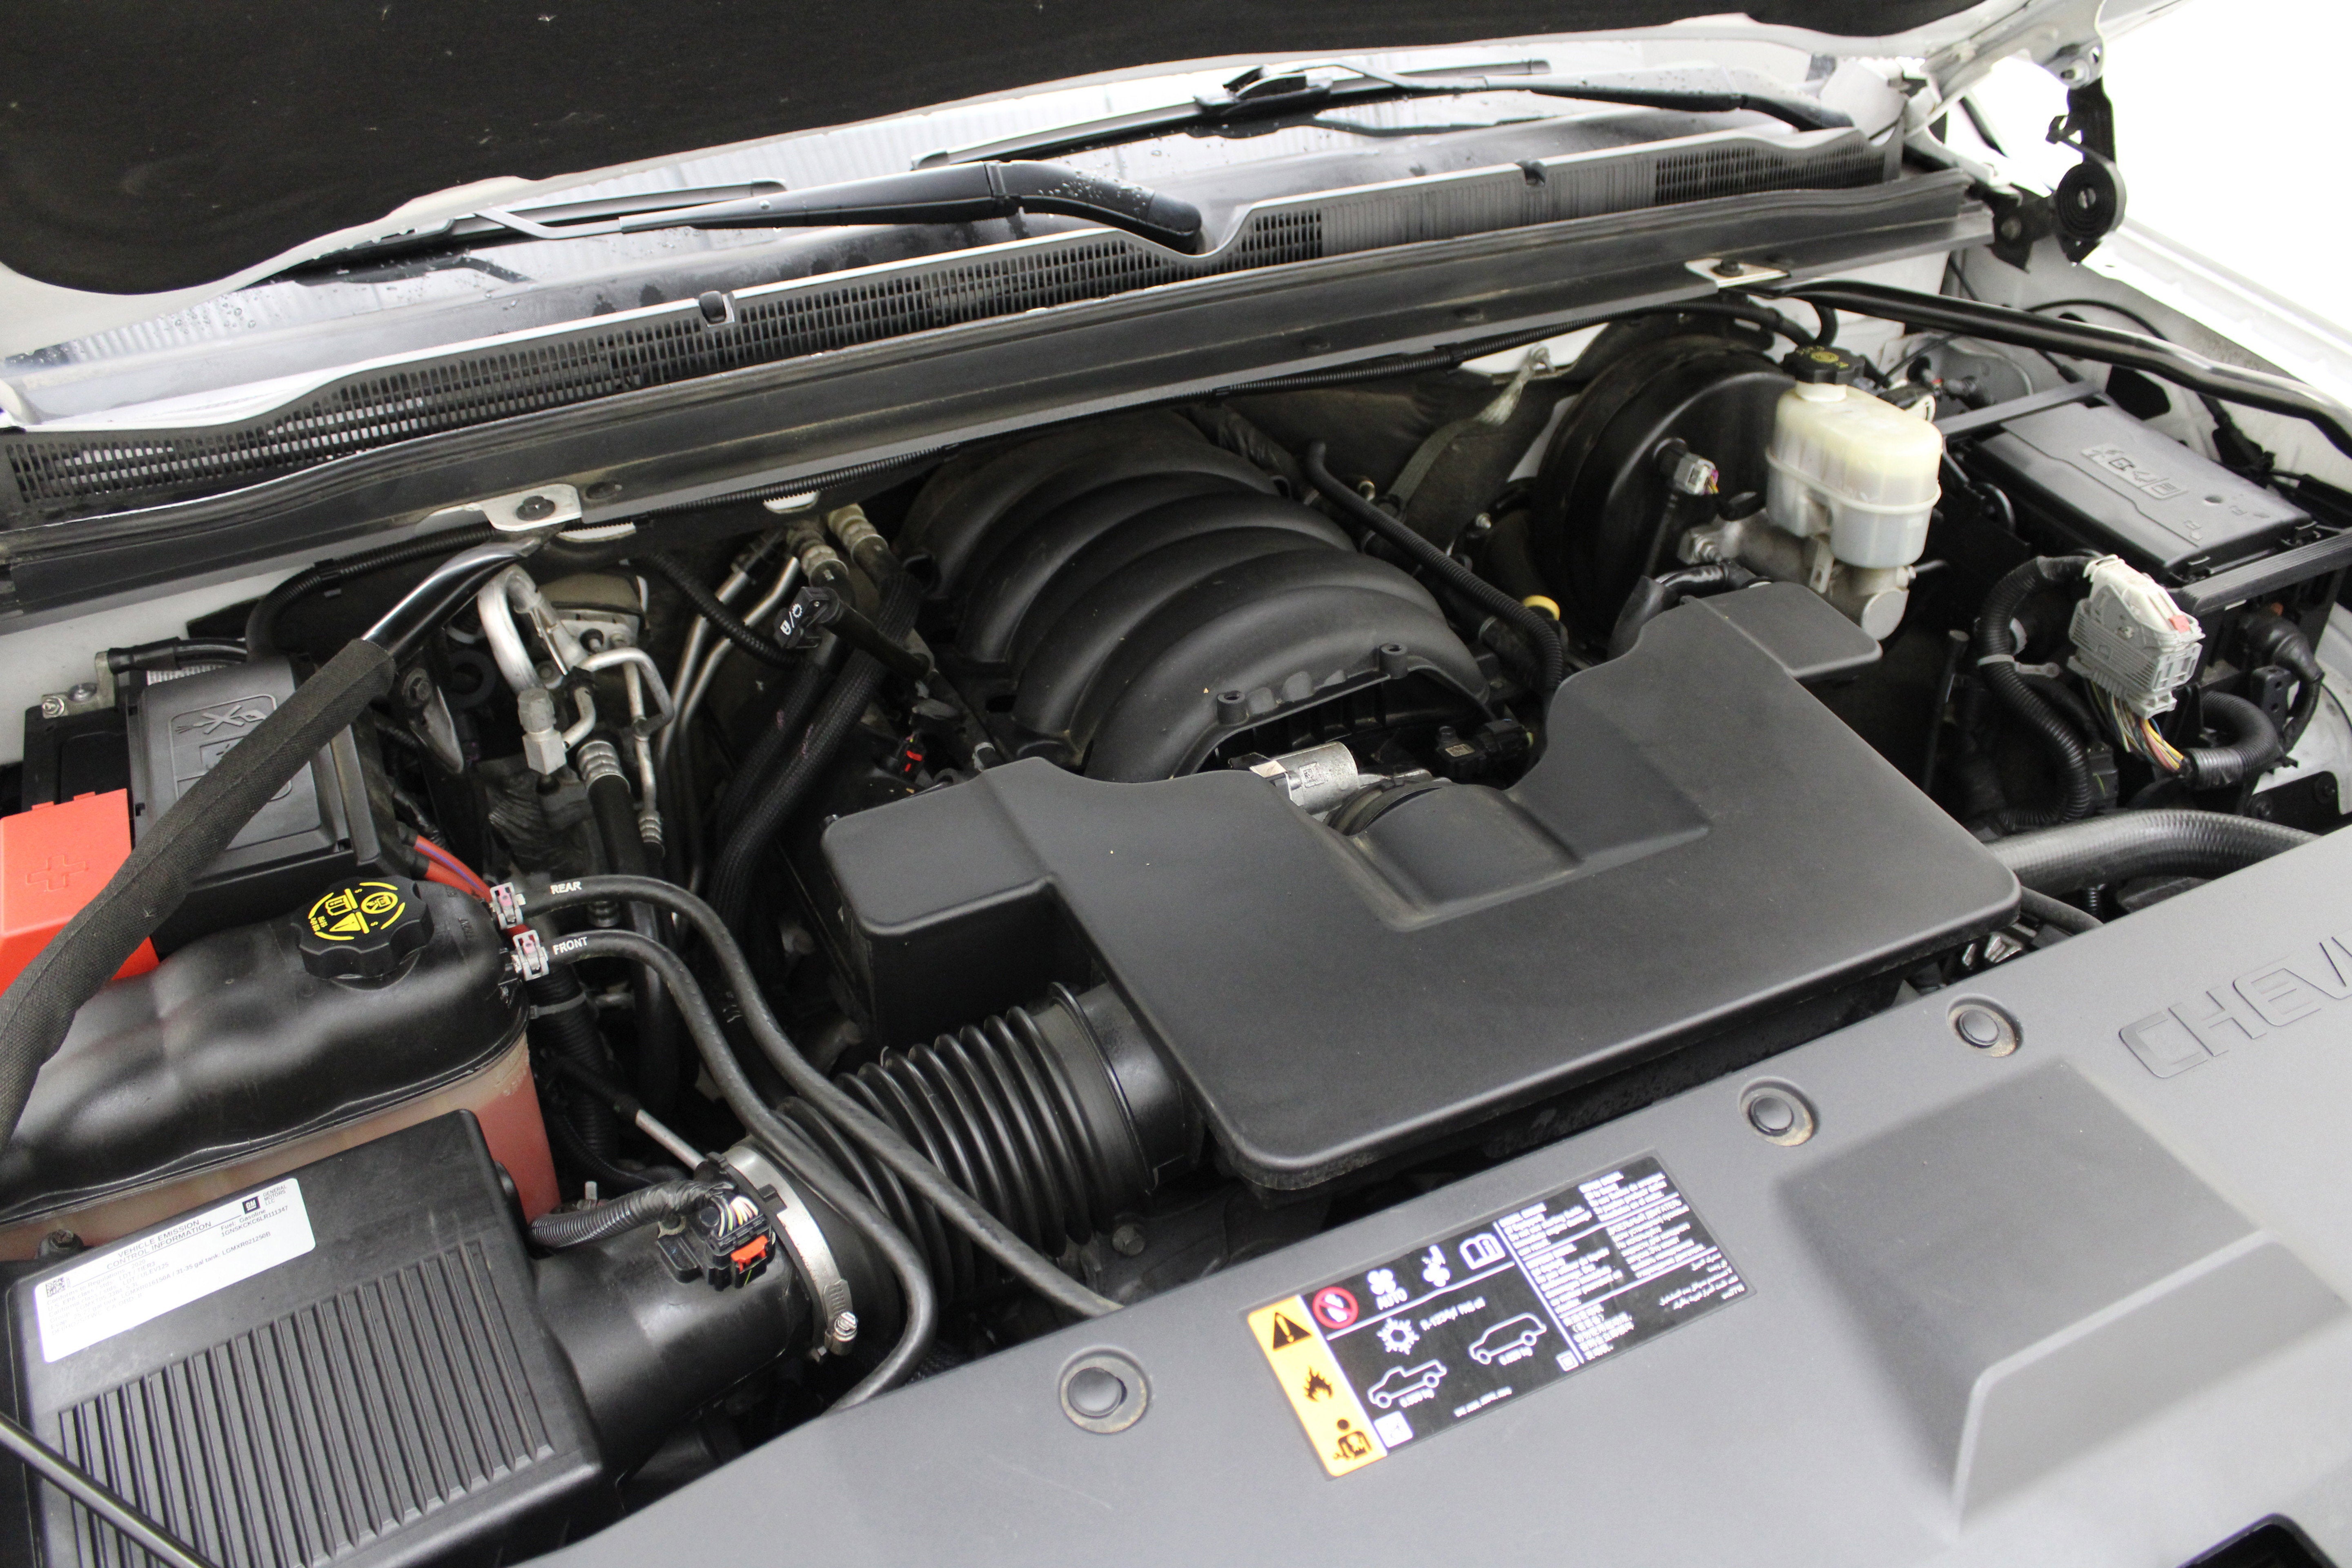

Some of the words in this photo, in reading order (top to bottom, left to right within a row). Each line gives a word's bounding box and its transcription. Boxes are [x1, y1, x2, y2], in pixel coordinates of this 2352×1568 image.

[550, 881, 582, 895] REAR
[552, 937, 587, 955] FRONT
[2118, 930, 2352, 1078] CHEV
[263, 1184, 287, 1197] GENERAL
[264, 1189, 286, 1201] MOTORS
[245, 1200, 257, 1210] GM
[220, 1221, 236, 1230] Fuel:
[239, 1209, 266, 1223] Gasoline
[106, 1247, 149, 1269] CONTROL
[150, 1221, 212, 1250] INFORMATION
[118, 1238, 156, 1258] VEHICLE
[157, 1220, 200, 1241] EMISSION
[175, 1264, 193, 1274] 31-35
[194, 1259, 204, 1268] gal
[205, 1252, 220, 1263] tank:
[221, 1231, 271, 1255] LGMXR021250B
[118, 1272, 131, 1280] LDT
[137, 1261, 156, 1272] TIER3
[131, 1259, 146, 1268] 2020
[140, 1262, 169, 1277] ULEV125
[1375, 1287, 1408, 1310] AUTO
